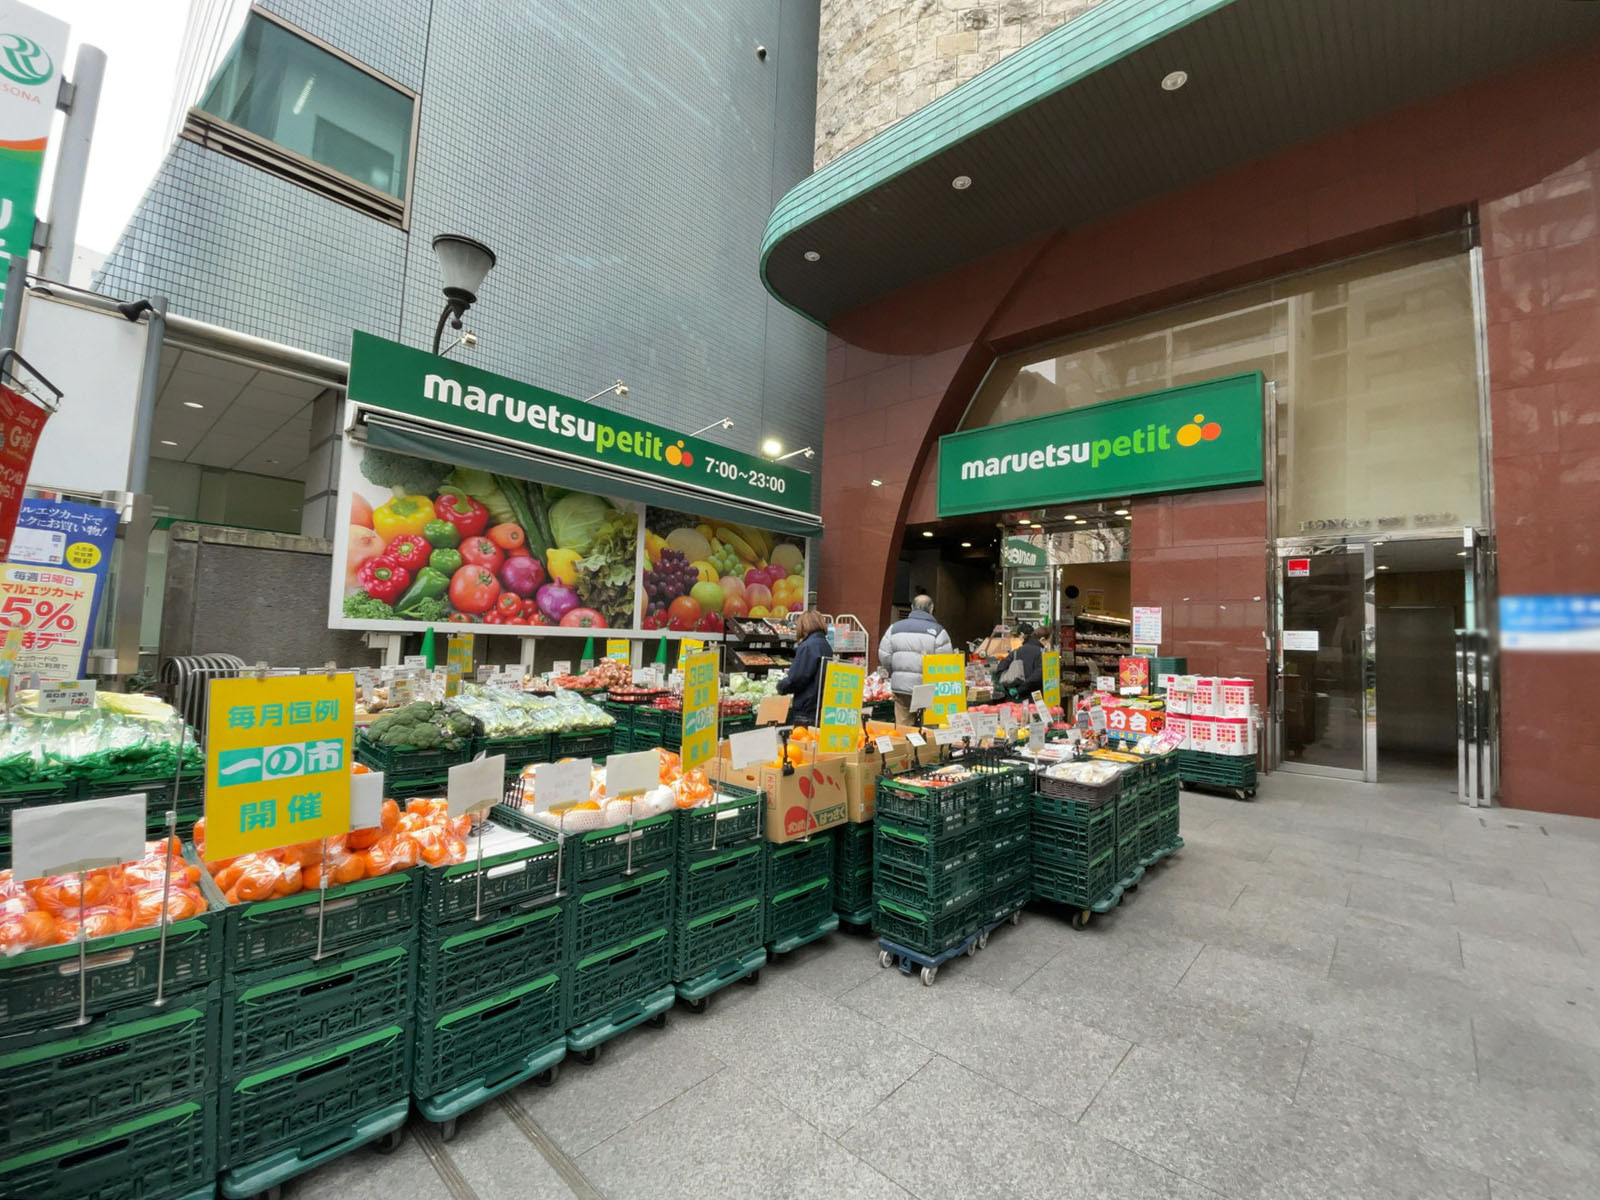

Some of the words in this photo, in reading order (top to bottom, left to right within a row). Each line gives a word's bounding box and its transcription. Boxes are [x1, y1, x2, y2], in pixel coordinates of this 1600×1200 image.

[705, 456, 786, 494] 7:00~23:00
[1, 583, 85, 601] マルエツカード
[14, 570, 74, 587] 毎週日曜日
[0, 596, 75, 631] 5%
[935, 682, 963, 695] の市
[227, 698, 339, 729] 毎月恒例
[1104, 709, 1147, 732] 分会
[219, 740, 342, 777] 一の市
[239, 792, 323, 833] 開催
